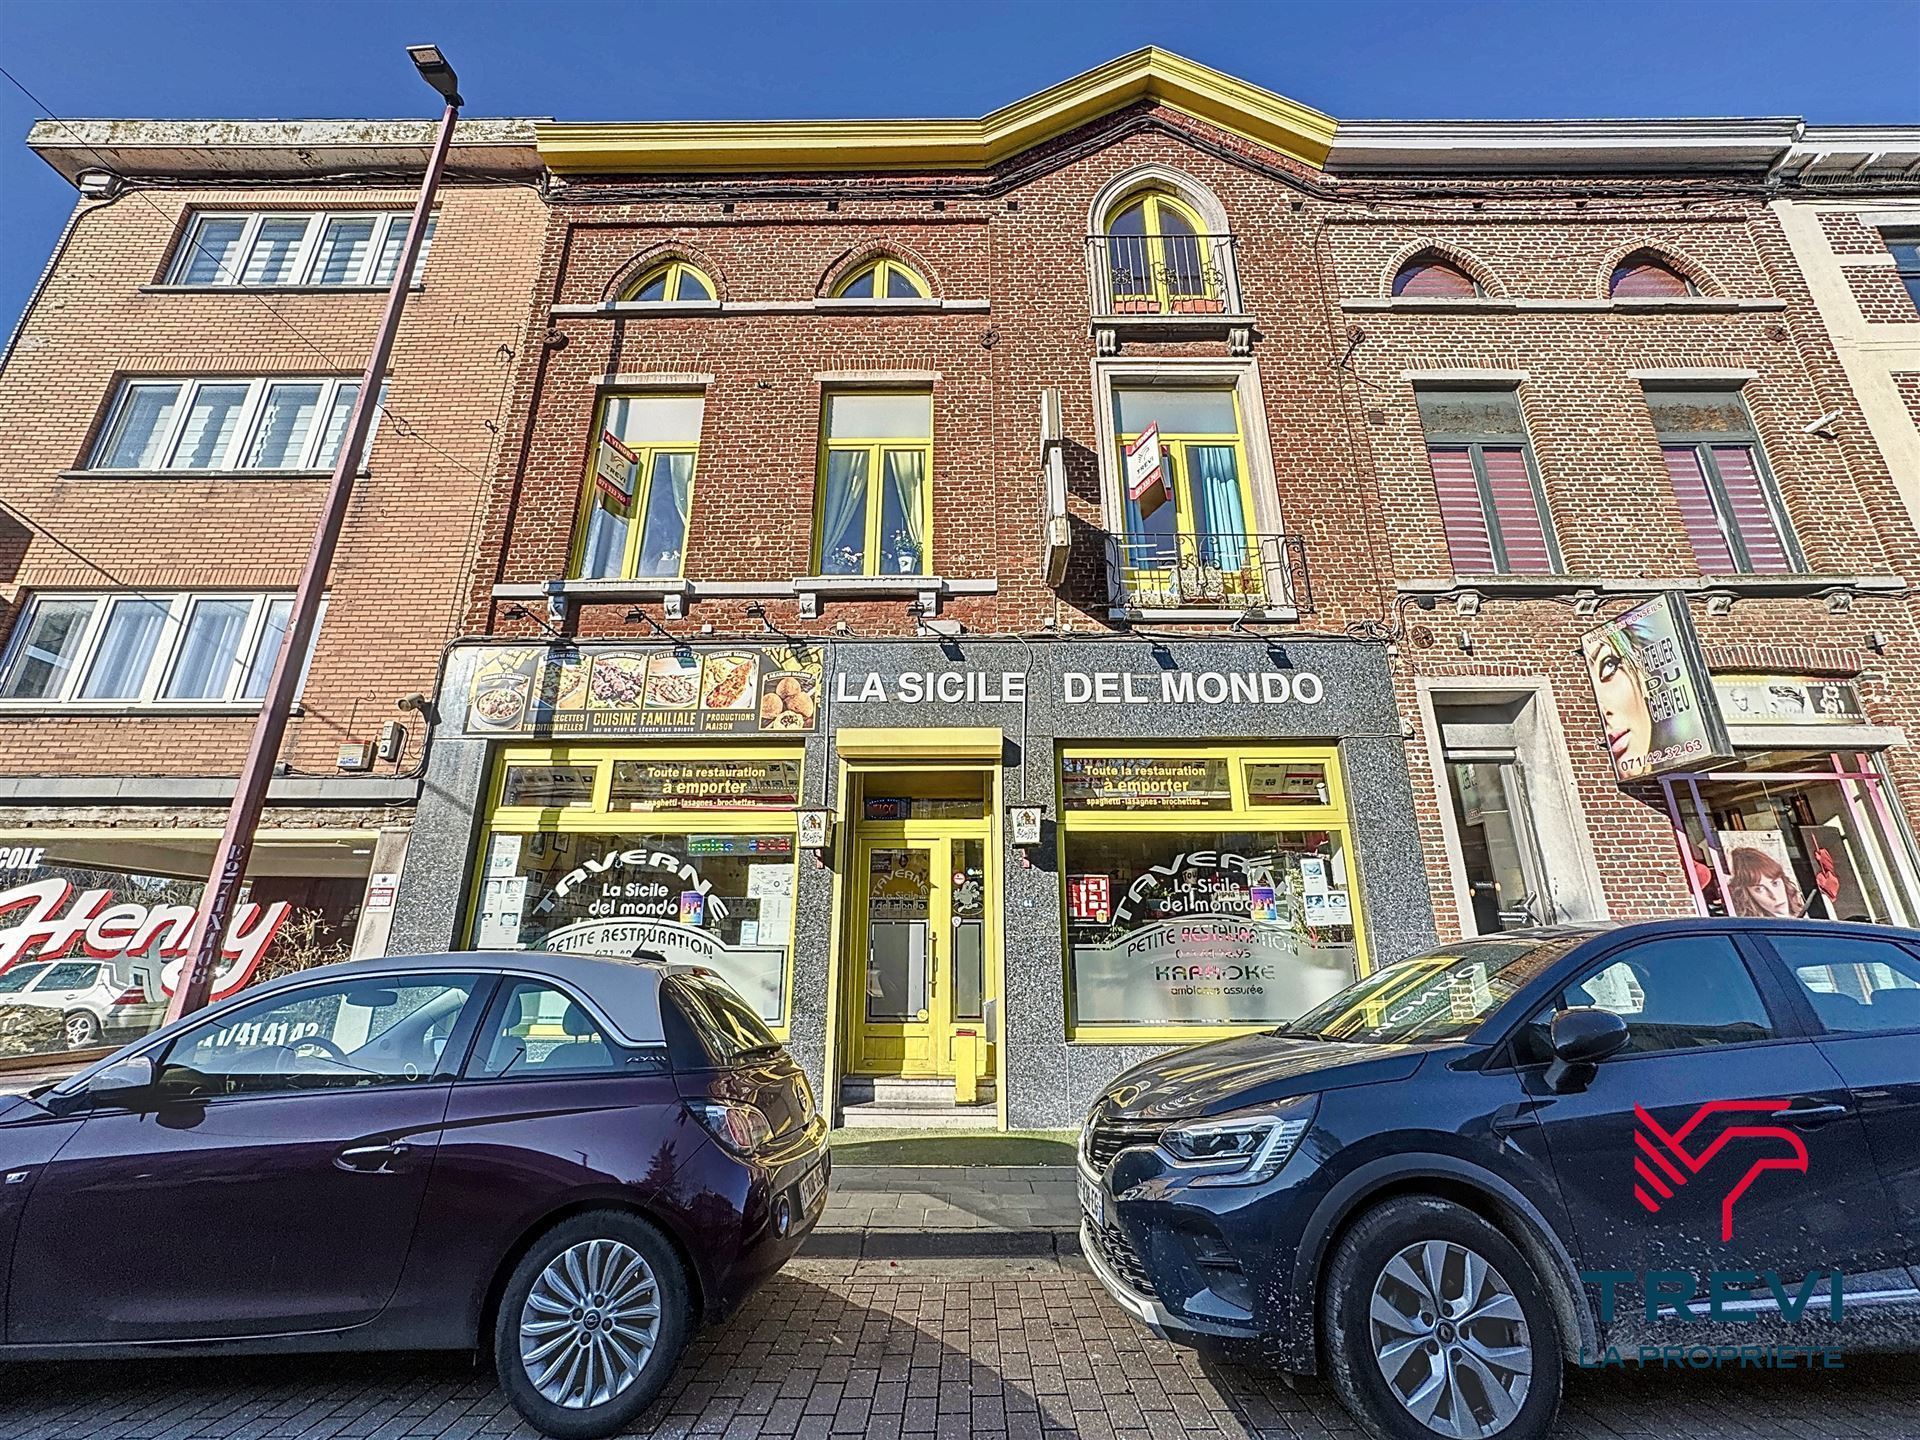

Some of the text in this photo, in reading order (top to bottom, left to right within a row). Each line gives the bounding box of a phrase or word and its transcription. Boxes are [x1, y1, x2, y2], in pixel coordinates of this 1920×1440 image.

[605, 463, 627, 483] TREVI
[1645, 667, 1681, 691] DU
[837, 672, 1323, 703] LA SICILE DEL MONDO
[1649, 684, 1691, 722] CHEVEU
[593, 712, 696, 726] CUISINE FAMILIALE
[706, 713, 755, 721] PRODUCTIONS
[705, 722, 733, 731] MAISON
[1620, 739, 1703, 772] 071/42.32.63
[648, 767, 766, 778] Toute la restauration
[1085, 765, 1206, 776] Toute la restauration
[662, 780, 747, 796] à emporter
[1103, 778, 1189, 794] à emporter
[602, 883, 669, 897] La Sicile
[872, 869, 928, 897] TAVERNE
[1197, 878, 1240, 893] Sicile
[588, 899, 678, 915] del mondo
[1160, 896, 1187, 912] del
[0, 878, 290, 1000] Heny
[600, 927, 713, 959] RESTAURATION
[1127, 924, 1299, 957] PETITE RESTAURATION
[1223, 984, 1264, 995] assurée
